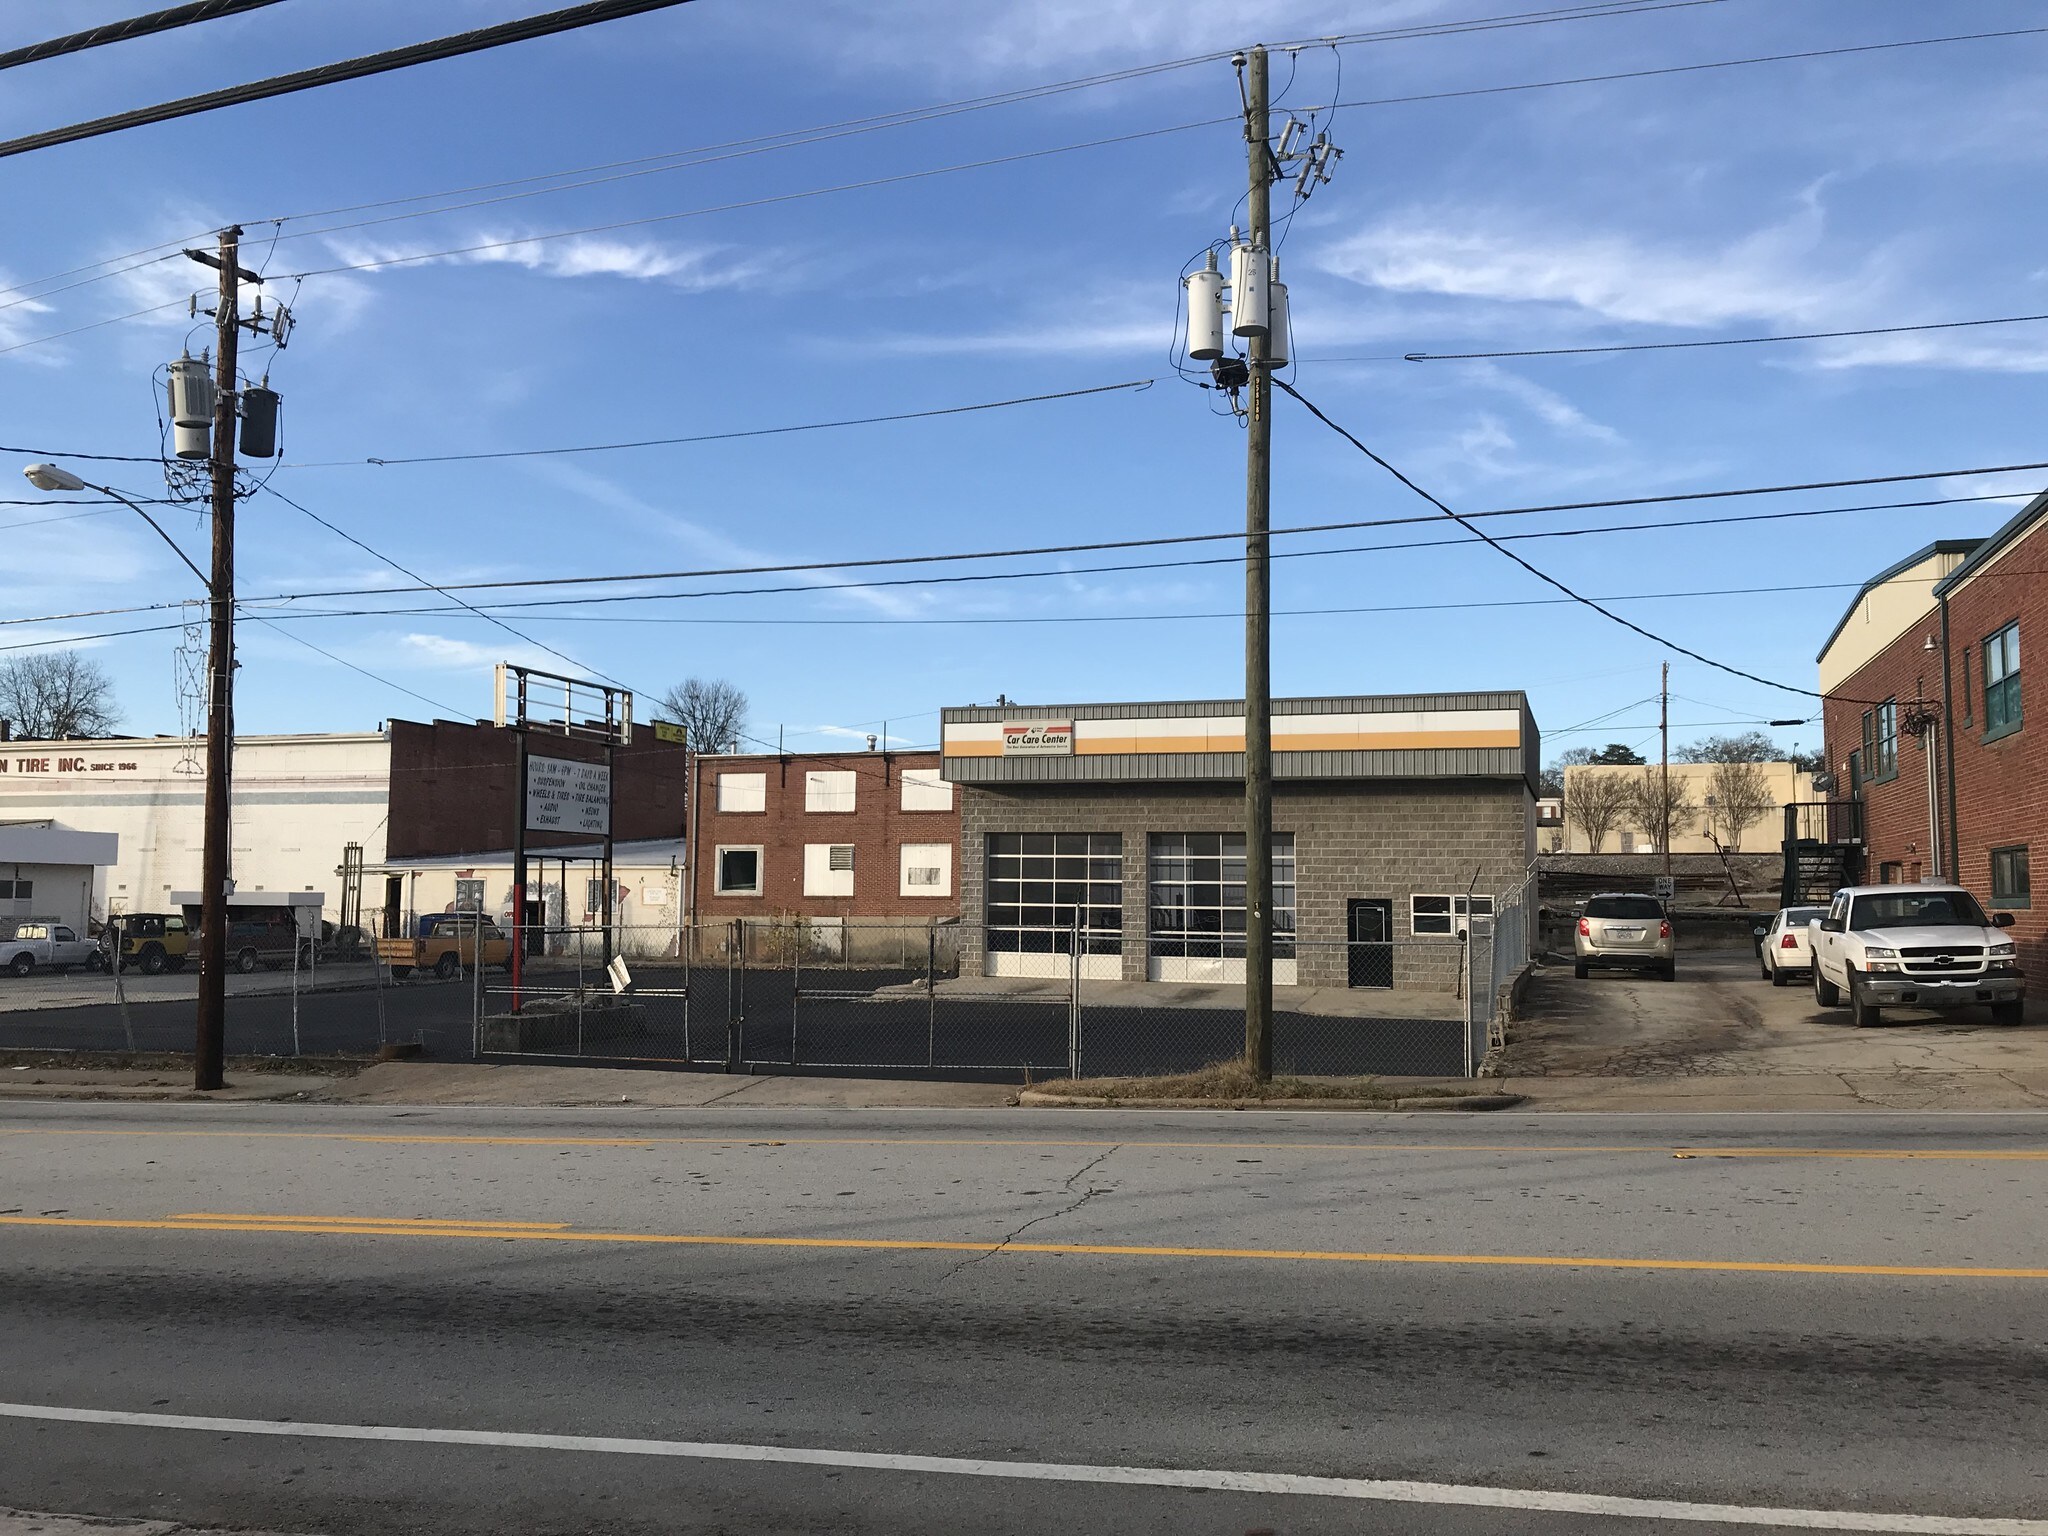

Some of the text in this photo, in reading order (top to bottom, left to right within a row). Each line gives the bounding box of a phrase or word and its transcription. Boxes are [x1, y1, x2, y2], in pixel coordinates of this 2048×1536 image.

[1007, 734, 1068, 744] Car Care Center
[16, 758, 50, 773] TIRE
[58, 757, 87, 772] INC.
[90, 763, 115, 771] SINCE
[118, 762, 137, 771] 1966
[537, 776, 567, 788] SUSPENSION
[578, 781, 607, 794] OIL CHANGES
[533, 788, 550, 799] WHEELS
[557, 791, 570, 801] TIRES
[575, 793, 609, 807] TIRE BALANCING
[544, 802, 559, 813] AUDIO
[540, 814, 561, 825] EXHAUST
[582, 819, 603, 830] LIGHTING
